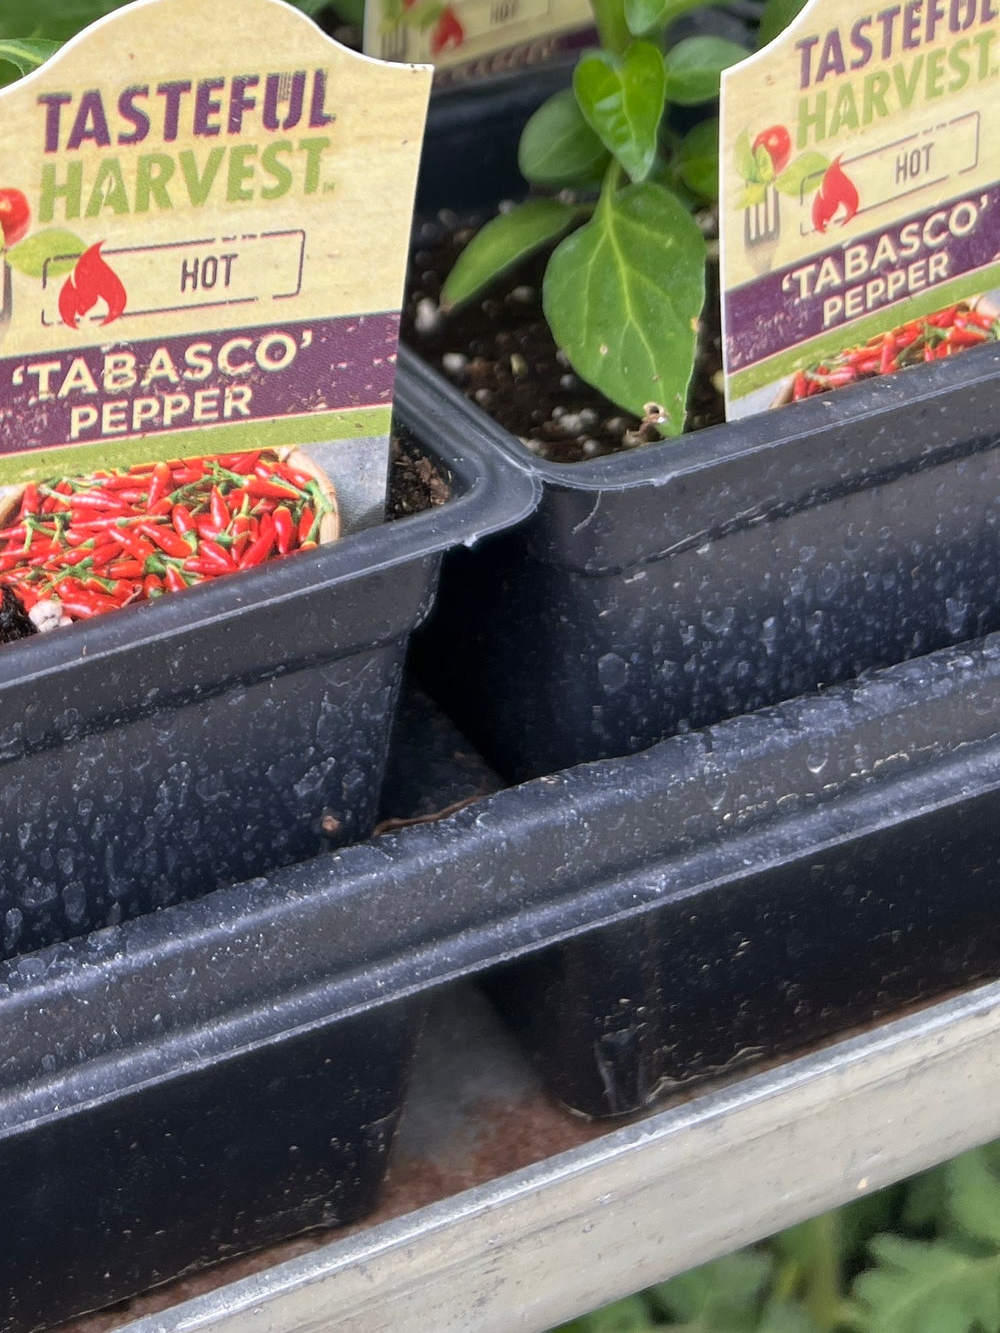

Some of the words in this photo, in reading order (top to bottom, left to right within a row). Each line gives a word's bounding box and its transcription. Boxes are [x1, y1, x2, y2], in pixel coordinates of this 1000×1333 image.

[37, 68, 336, 154] TASTEFUL
[796, 30, 996, 150] HARVEST
[38, 137, 331, 223] HARVEST
[895, 142, 935, 184] HOT
[180, 253, 239, 293] HOT
[822, 252, 950, 328] PEPPER
[68, 385, 253, 439] PEPPER
